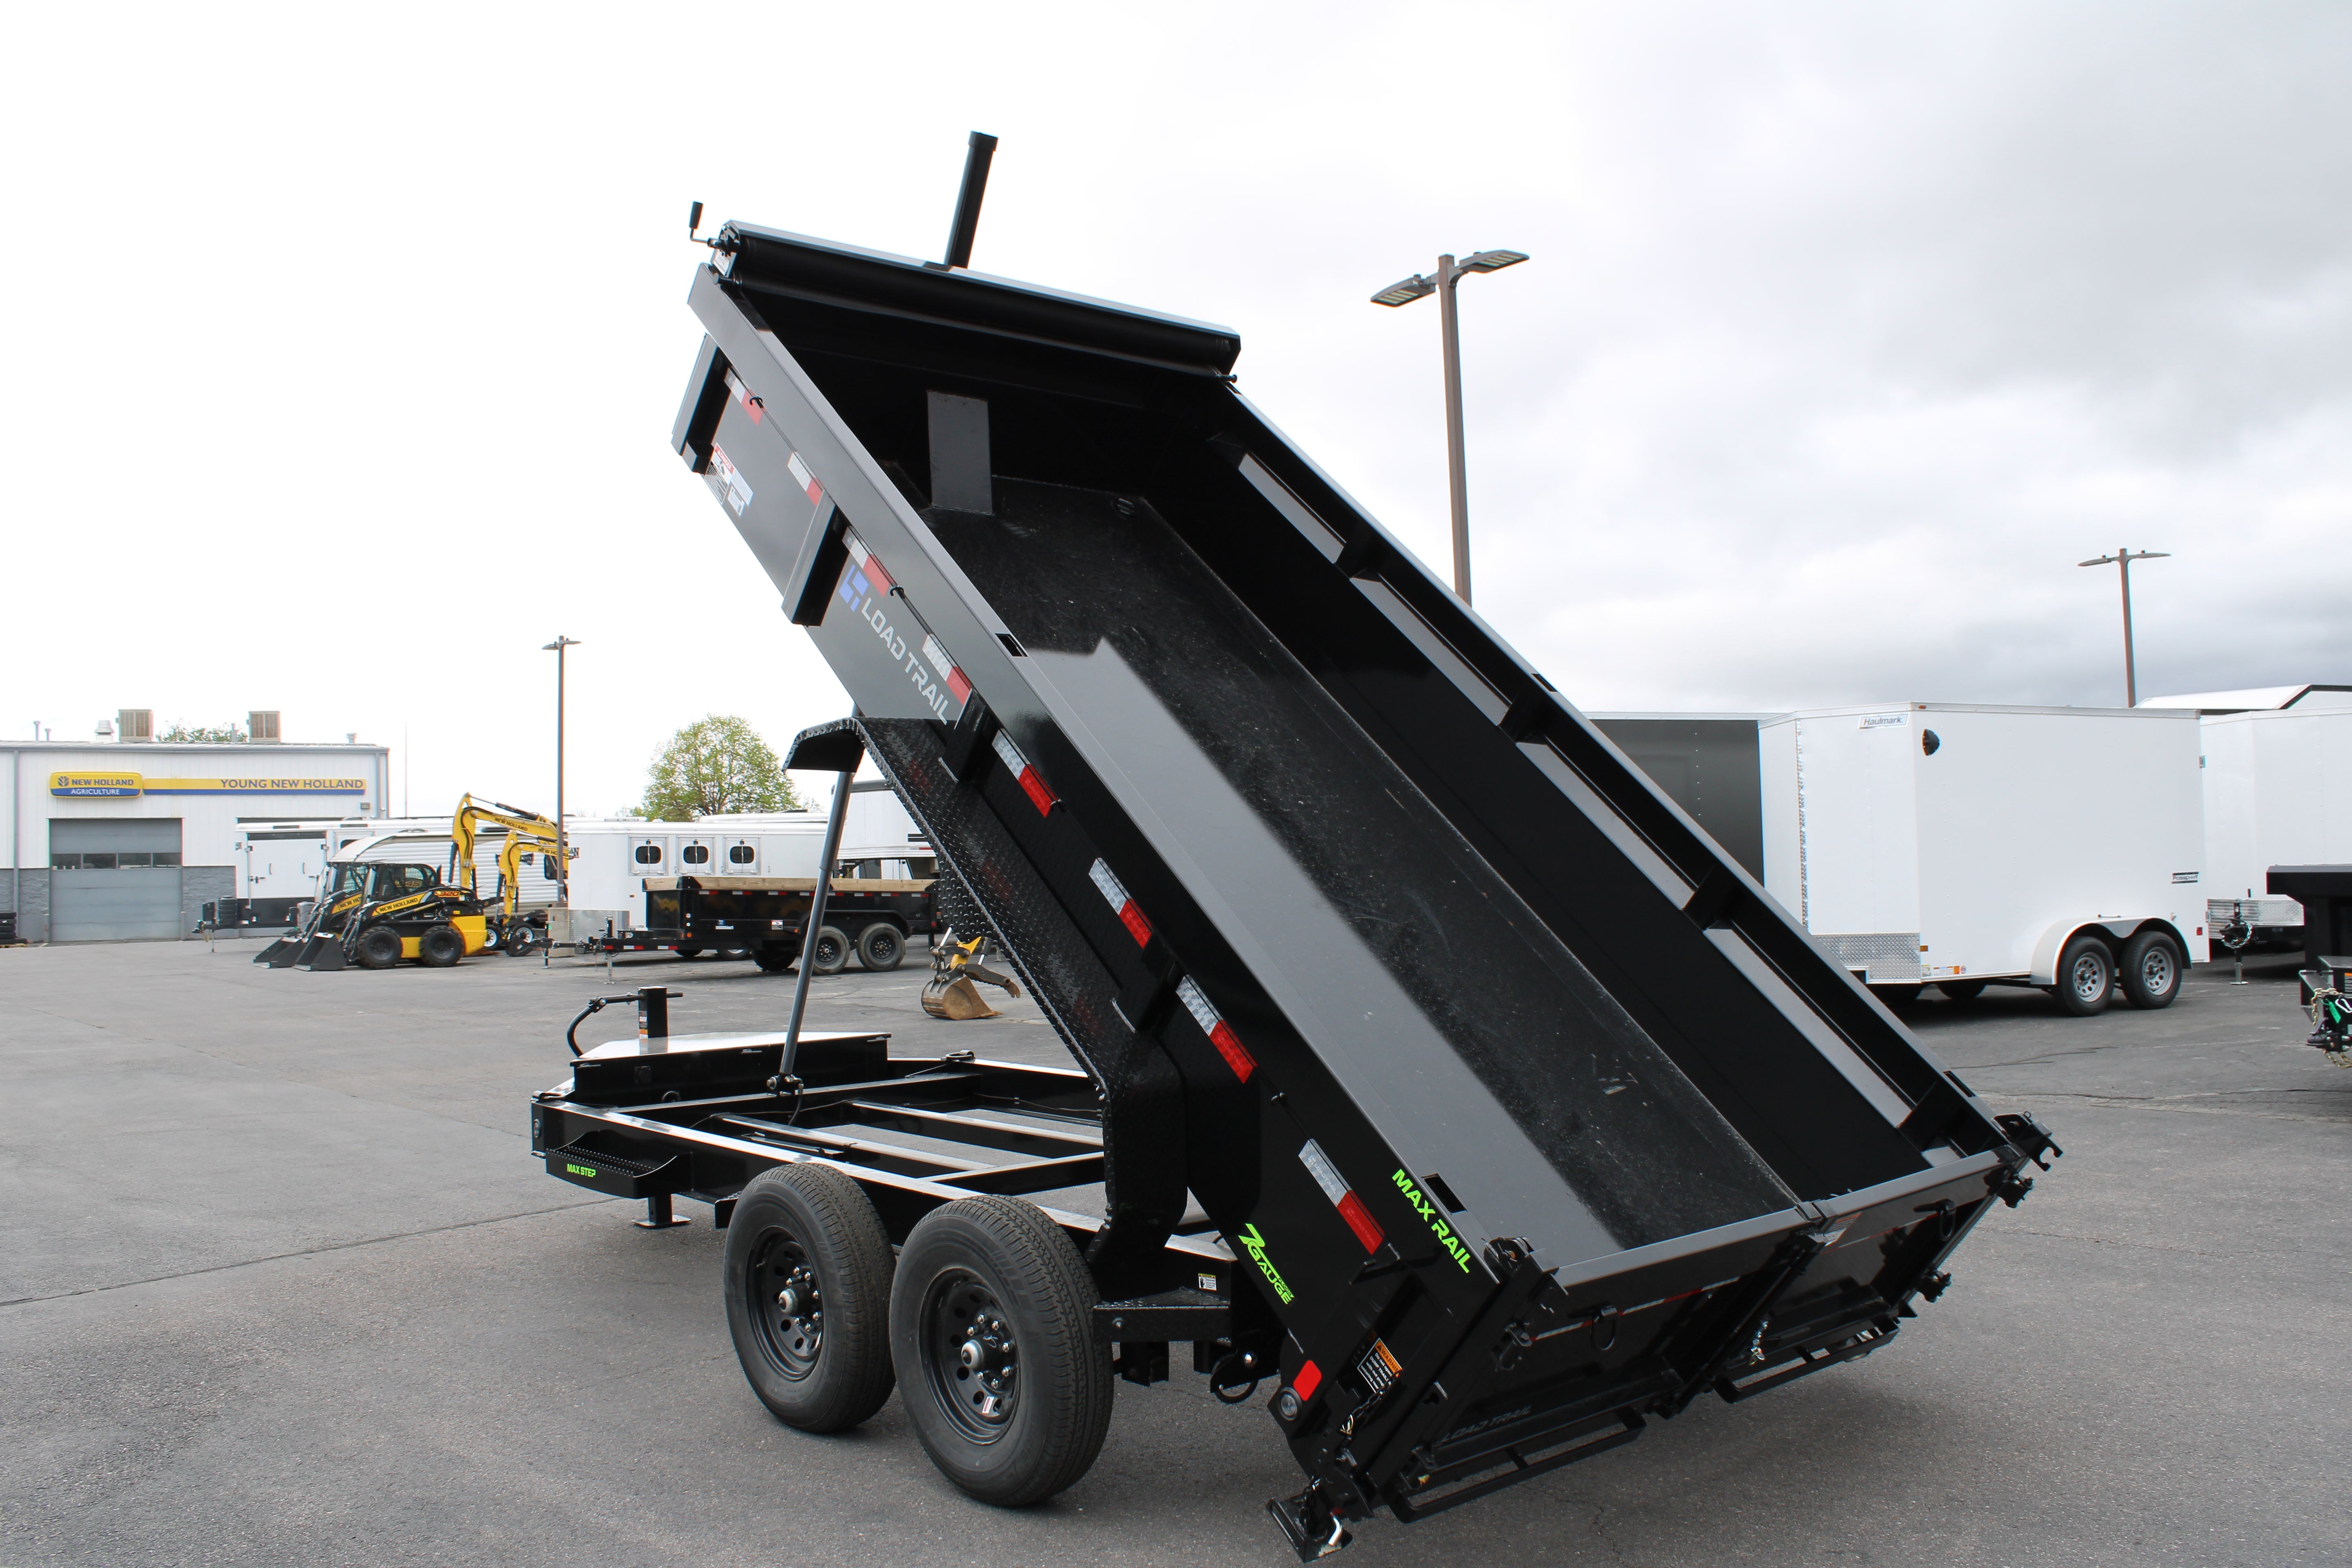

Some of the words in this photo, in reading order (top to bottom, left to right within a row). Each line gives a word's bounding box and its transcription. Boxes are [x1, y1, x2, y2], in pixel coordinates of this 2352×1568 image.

[862, 597, 906, 661] LOAD
[905, 652, 949, 725] TRAIL
[1864, 716, 1901, 726] Haulmark
[220, 780, 267, 788] YOUNG
[271, 780, 300, 788] NEW
[303, 780, 363, 788] HOLLAND
[506, 821, 528, 831] HOLLAND
[393, 898, 418, 909] HOLLAND
[567, 1163, 580, 1174] MAX
[580, 1167, 596, 1178] STEP
[1392, 1169, 1436, 1222] MAX
[1431, 1218, 1470, 1274] RAIL
[1381, 1349, 1399, 1372] WARNI
[1361, 1365, 1373, 1382] securing
[1370, 1356, 1379, 1368] DUMP
[1379, 1367, 1392, 1385] TRAILR
